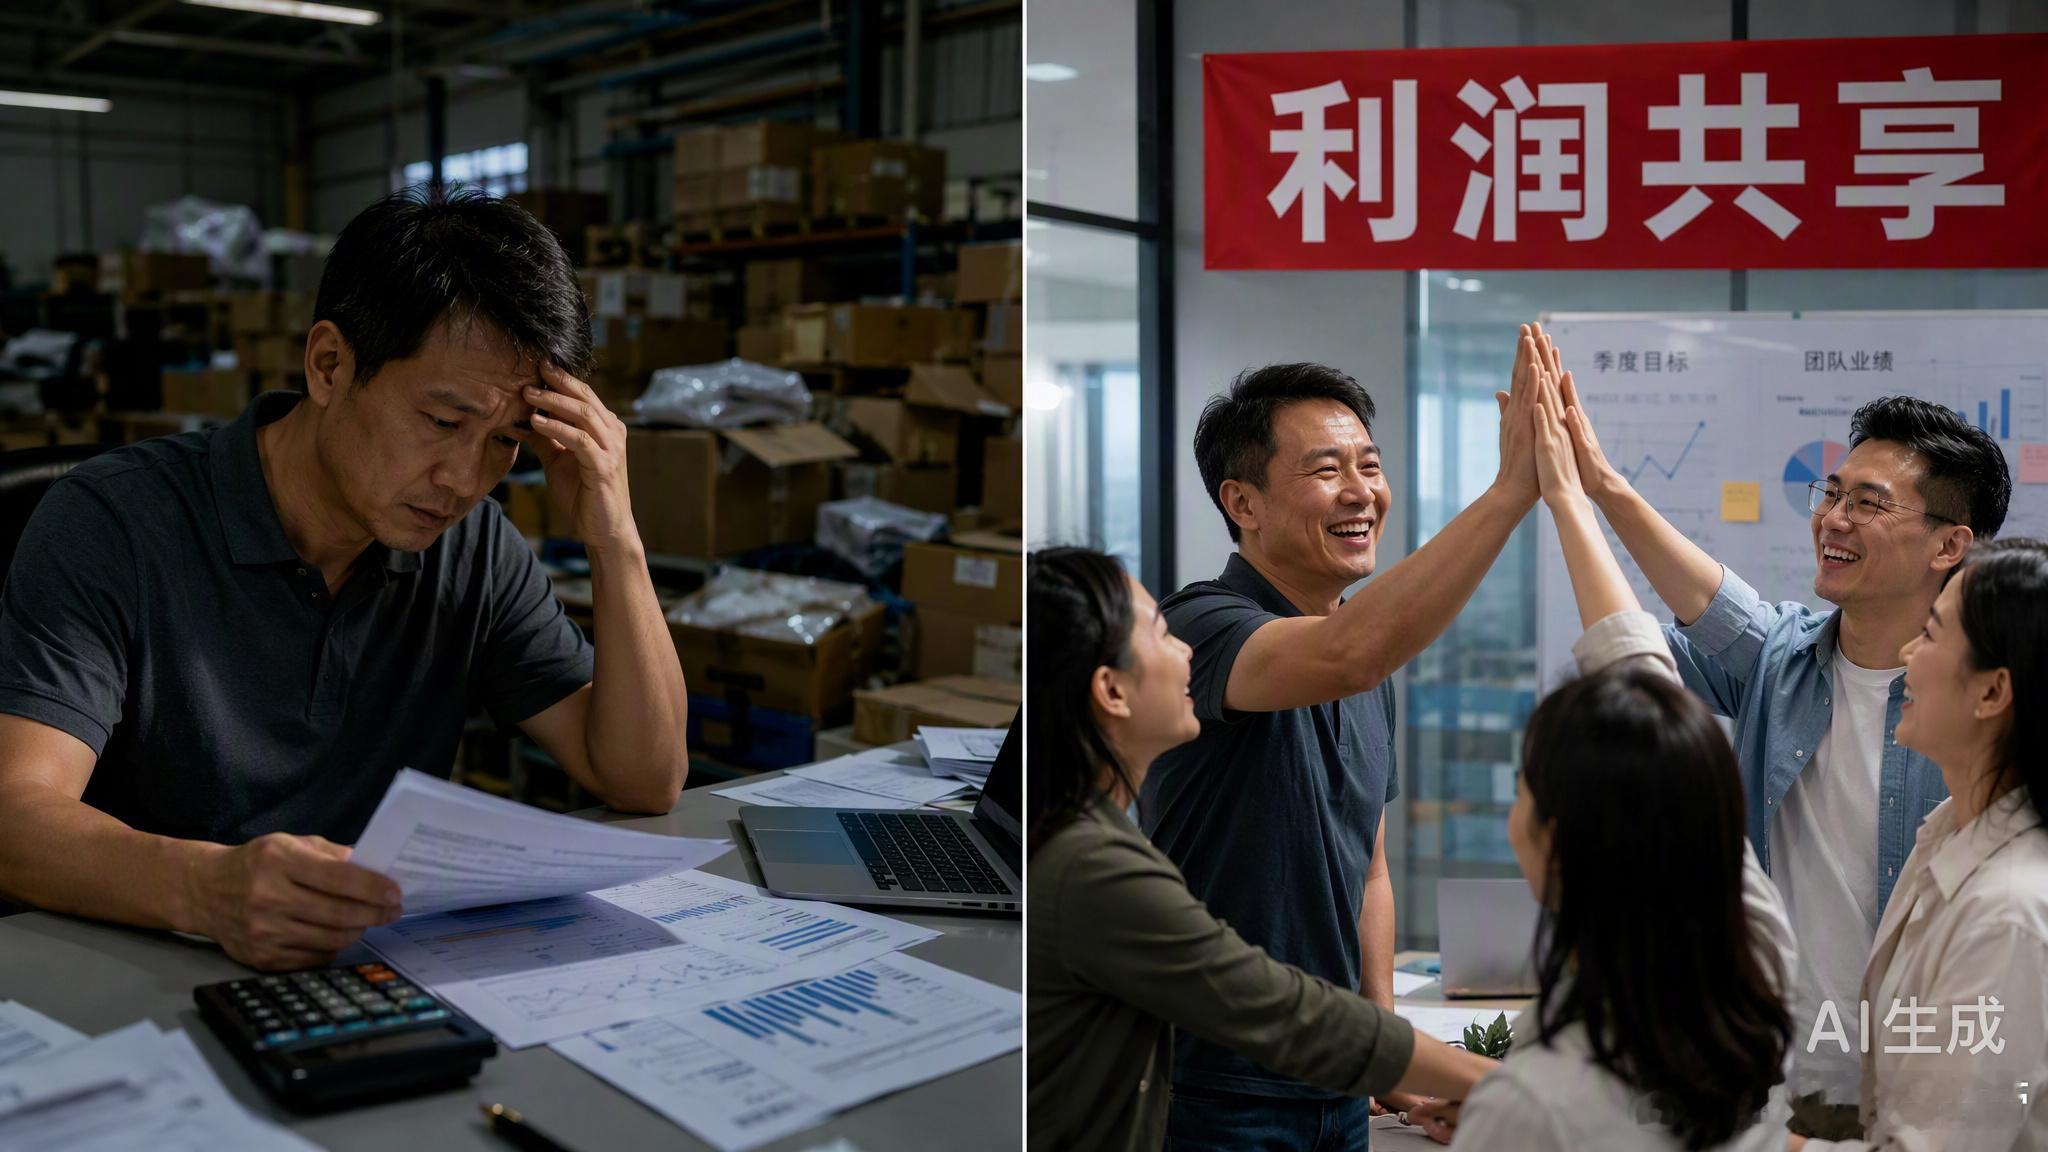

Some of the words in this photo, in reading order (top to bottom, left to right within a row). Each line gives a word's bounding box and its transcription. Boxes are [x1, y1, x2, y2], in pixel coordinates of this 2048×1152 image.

[1267, 67, 2005, 243] 利润共享
[1593, 350, 1688, 373] 季度目标
[1804, 350, 1893, 372] 团队业绩
